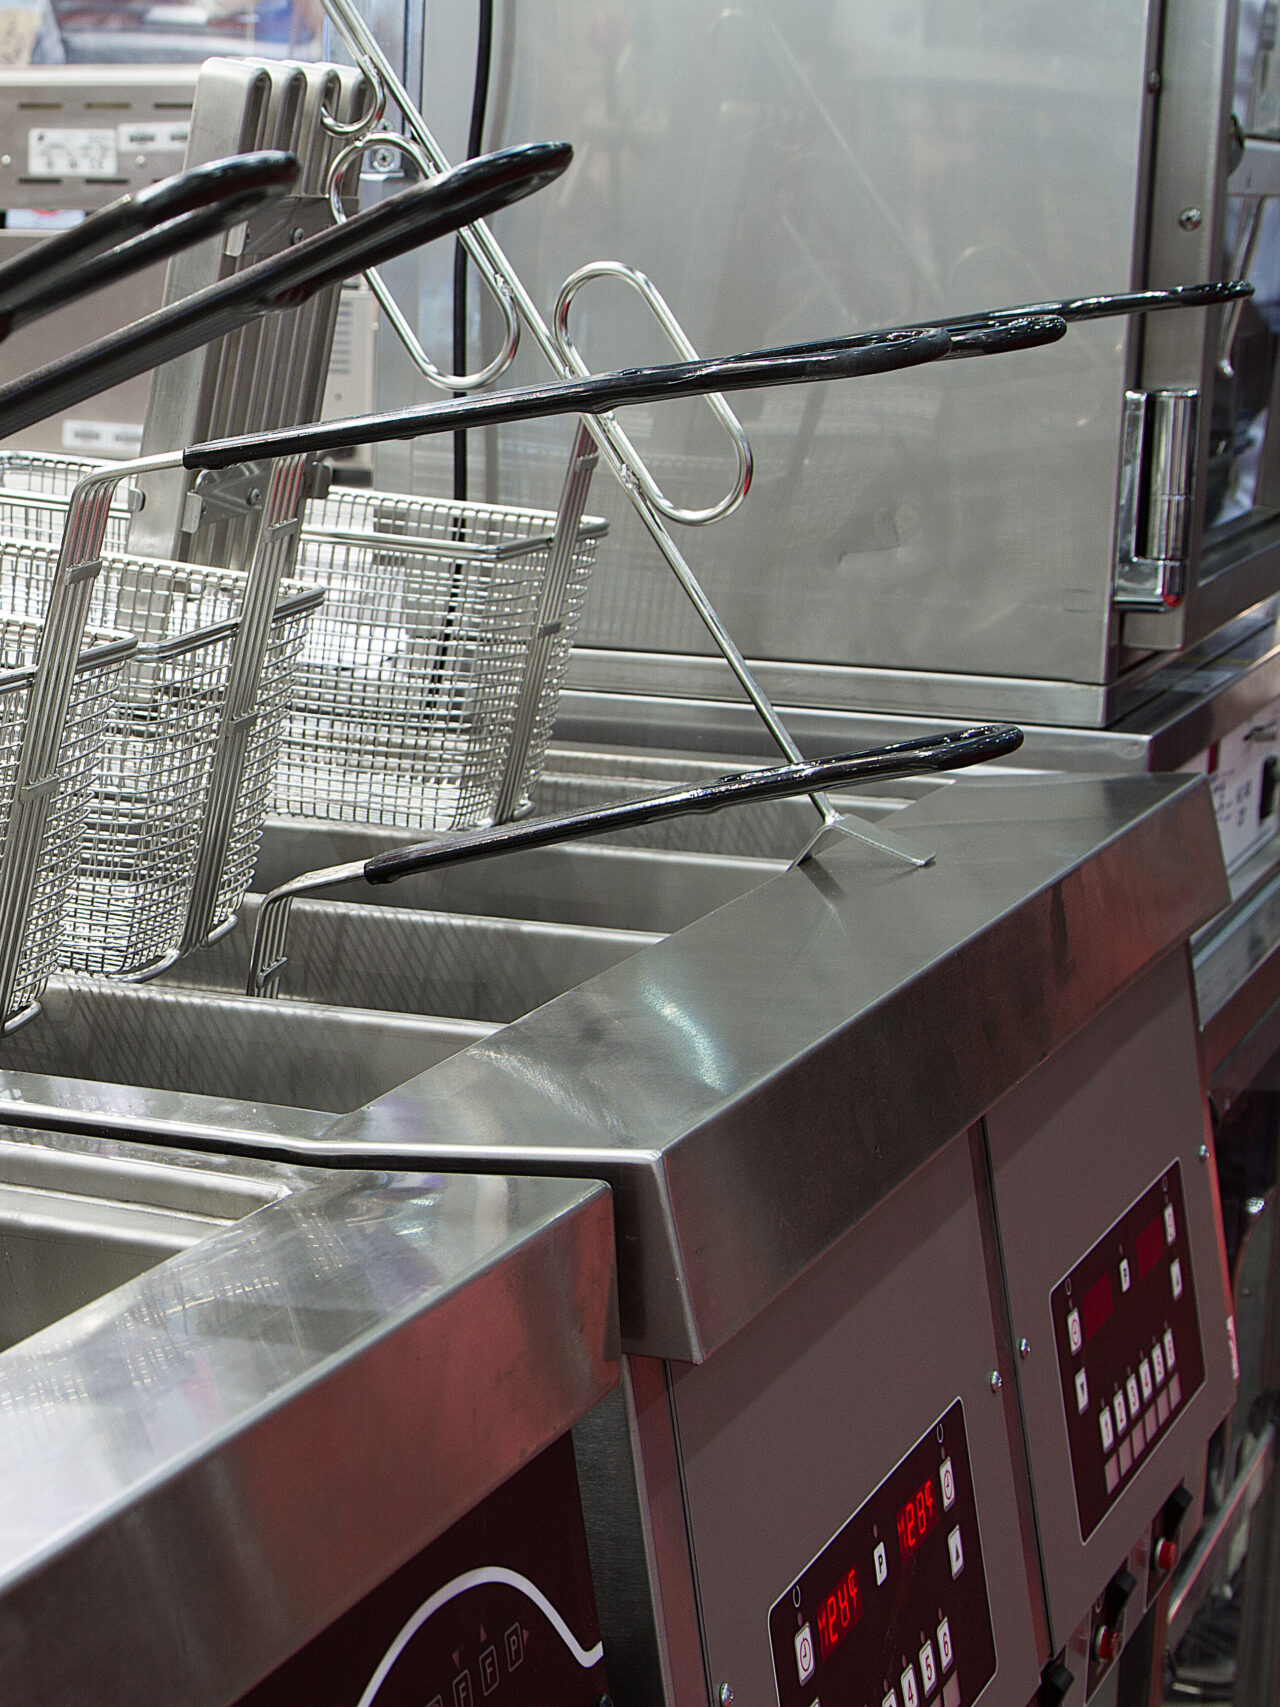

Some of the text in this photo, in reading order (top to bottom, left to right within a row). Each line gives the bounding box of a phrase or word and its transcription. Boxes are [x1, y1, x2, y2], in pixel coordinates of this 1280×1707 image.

[510, 1635, 518, 1660] P
[943, 1632, 949, 1657] 6
[485, 1657, 493, 1683] F
[926, 1654, 932, 1681] 5
[908, 1679, 914, 1704] 4
